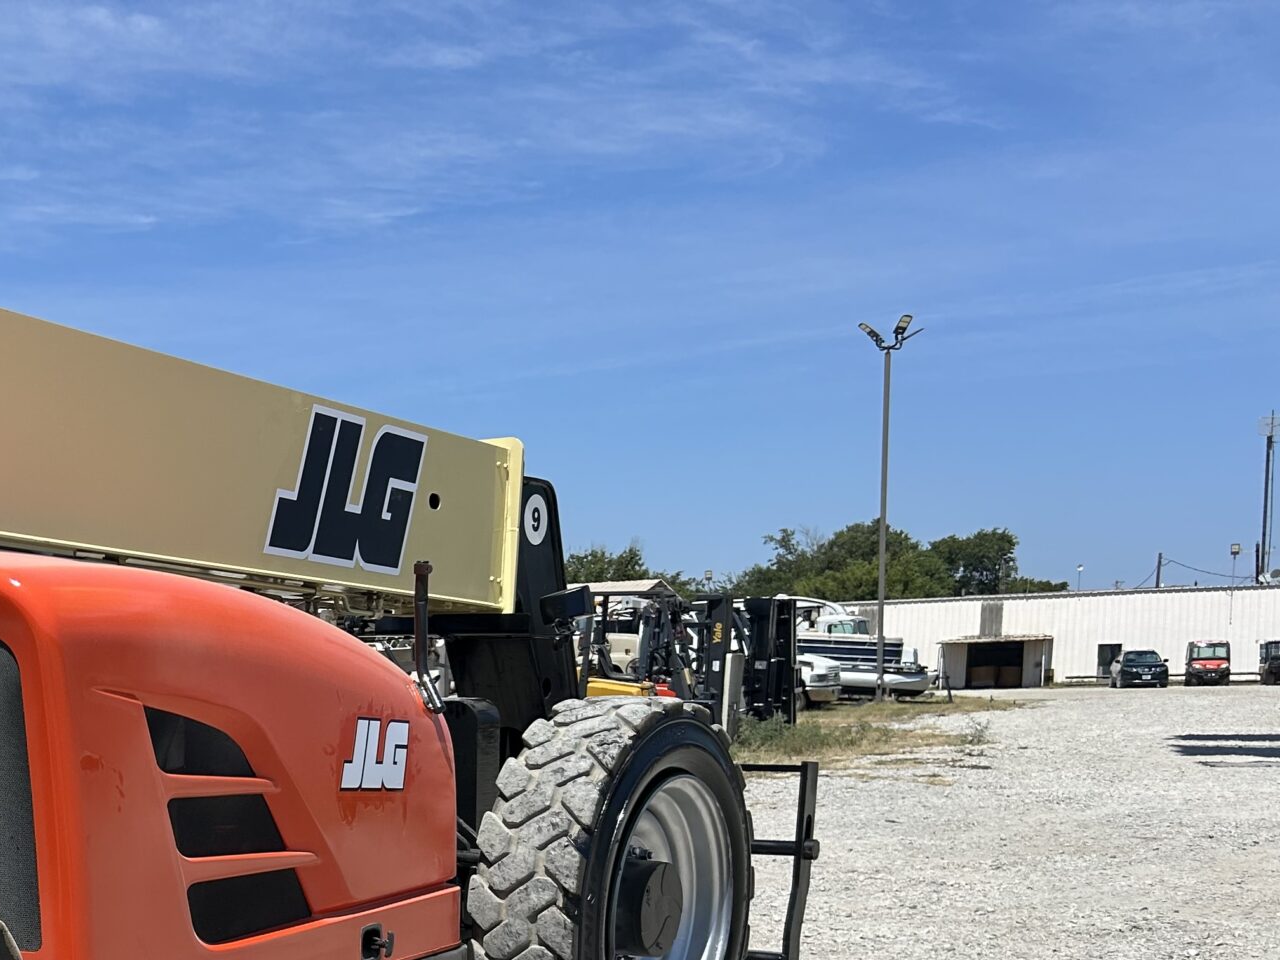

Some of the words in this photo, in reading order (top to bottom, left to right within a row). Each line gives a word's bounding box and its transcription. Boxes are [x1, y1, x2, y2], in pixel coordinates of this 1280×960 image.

[264, 404, 428, 575] JLG
[531, 506, 541, 532] 9
[340, 716, 410, 791] JLG
